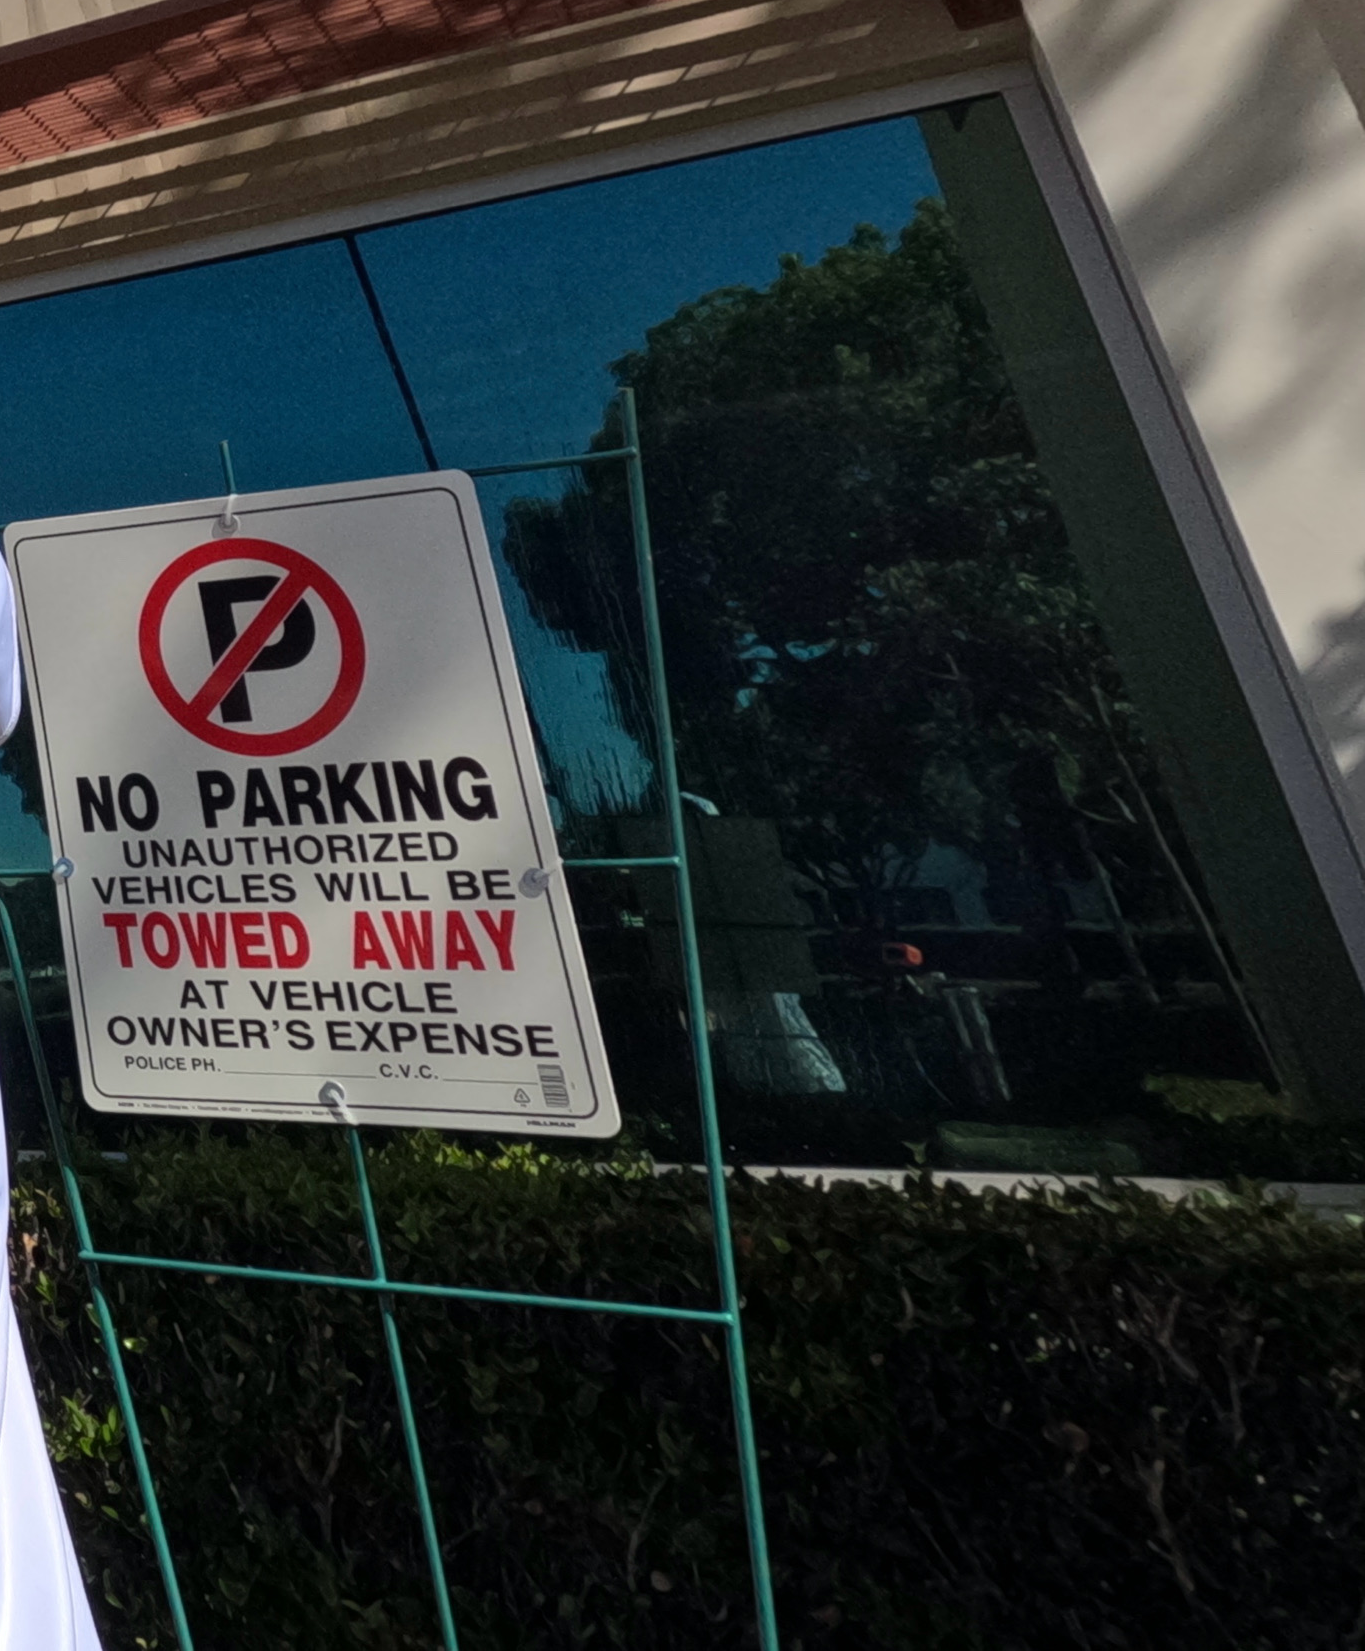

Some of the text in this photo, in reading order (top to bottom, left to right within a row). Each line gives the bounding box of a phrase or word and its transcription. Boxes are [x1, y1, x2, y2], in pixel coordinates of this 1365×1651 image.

[75, 756, 500, 833] NO PARKING
[121, 830, 459, 869] UNAUTHORIZED
[91, 869, 516, 905] VEHICLES WILL BE
[102, 909, 516, 972] TOWED AWAY
[179, 979, 458, 1015] AT VEHICLE
[106, 1015, 560, 1058] OWNER'S EXPENSE
[124, 1055, 439, 1080] POLICE PH. C.V.C.
